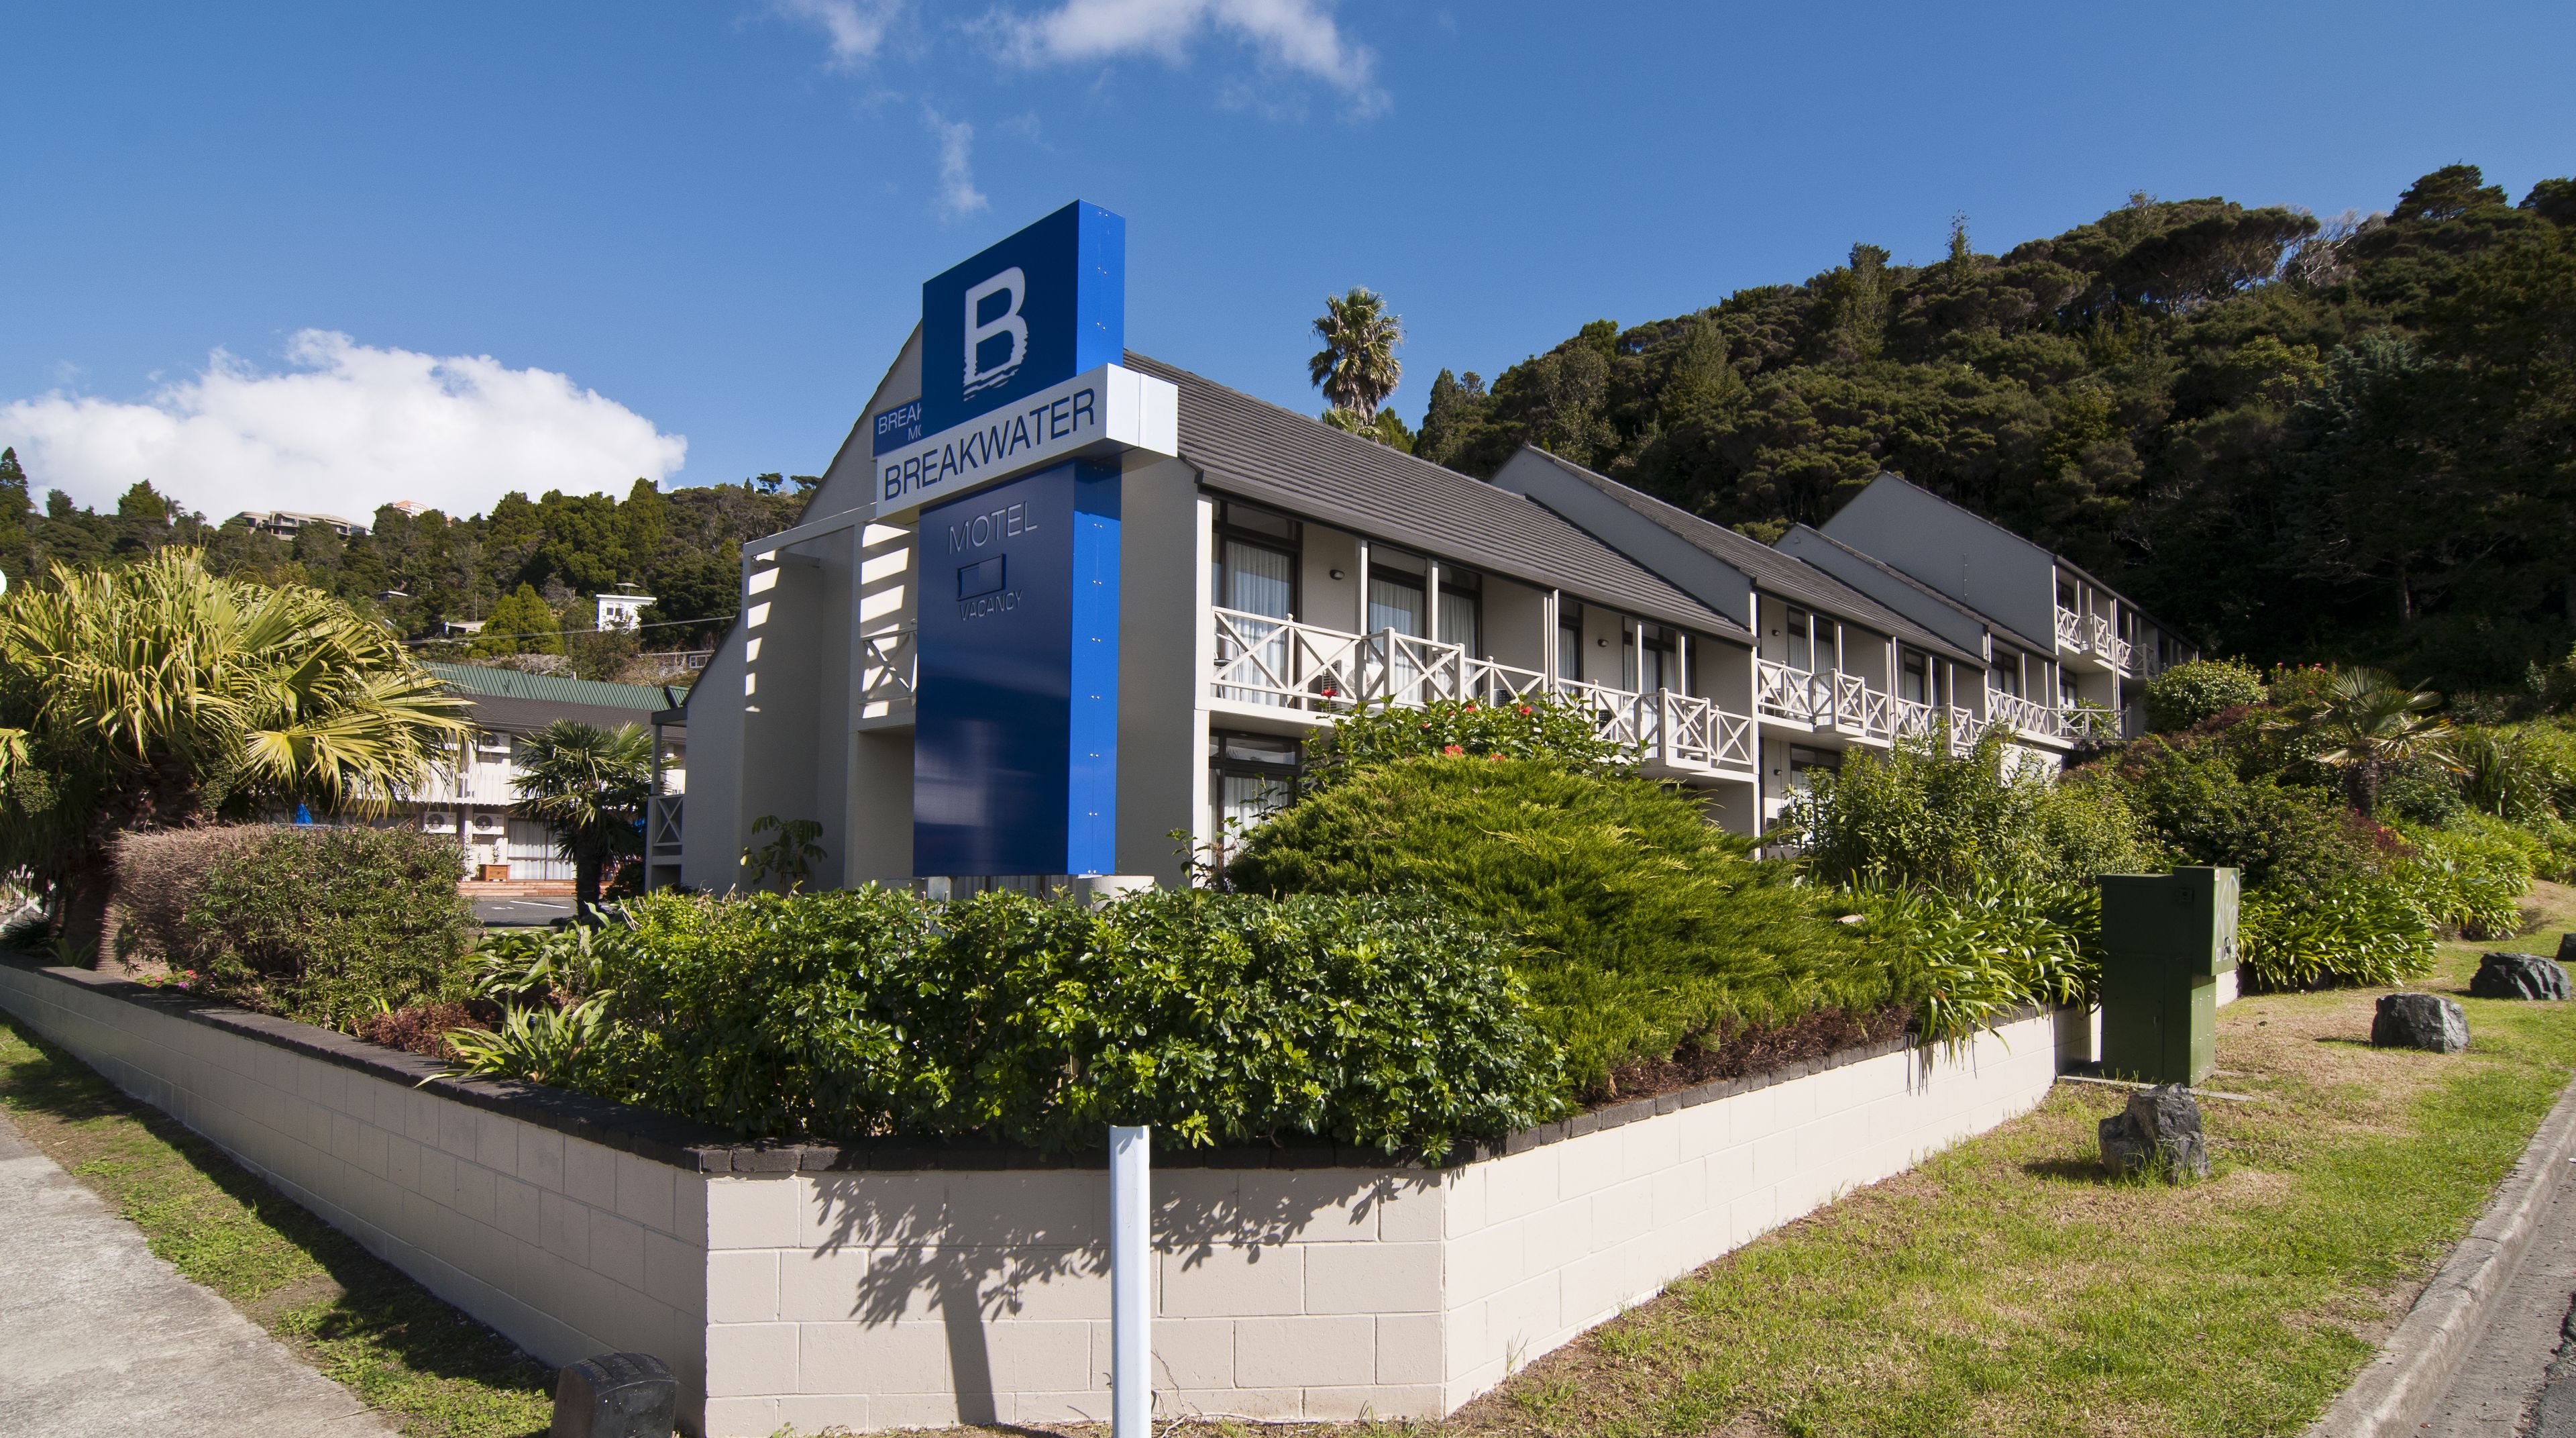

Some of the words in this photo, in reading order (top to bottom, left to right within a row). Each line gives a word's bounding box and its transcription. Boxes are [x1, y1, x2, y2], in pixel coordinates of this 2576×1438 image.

[963, 266, 1028, 402] B
[884, 387, 1095, 501] BREAKWATER
[949, 501, 1038, 555] MOTEL
[959, 589, 1023, 621] VACANCY
